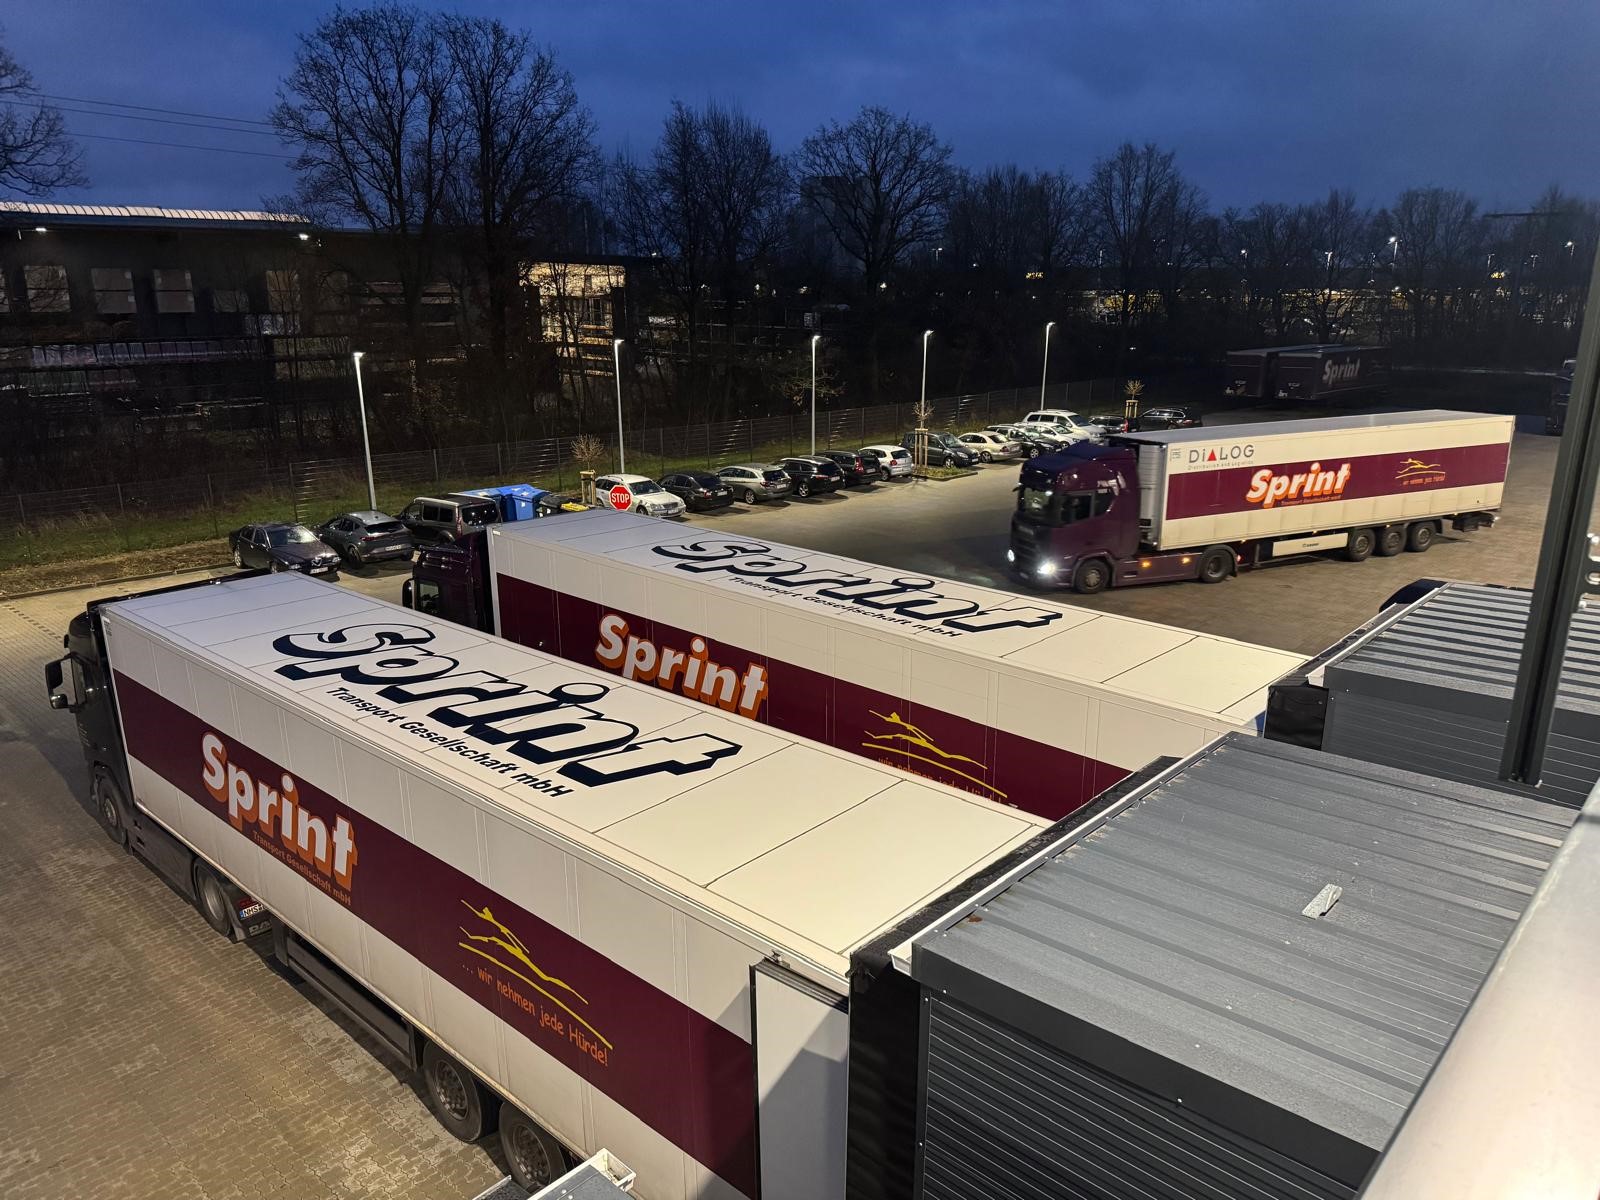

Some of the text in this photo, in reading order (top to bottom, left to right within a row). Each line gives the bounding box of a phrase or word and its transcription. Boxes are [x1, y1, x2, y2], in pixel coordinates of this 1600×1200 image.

[1322, 356, 1361, 385] Sprint
[611, 492, 630, 504] STOP
[1246, 462, 1351, 508] Sprint
[652, 539, 1063, 633] Sprint
[728, 576, 963, 637] Transport Gesellschaft mbH
[272, 623, 743, 788] Sprint
[595, 612, 768, 721] Sprint
[326, 687, 575, 798] Transport Gesellschaft mbH
[202, 731, 359, 891] Sprint
[252, 830, 352, 905] Transport Gesellschaft mbH
[477, 967, 493, 985] wir
[496, 979, 536, 1017] nehmen
[539, 1005, 565, 1036] jede
[568, 1023, 609, 1067] Hürde!
